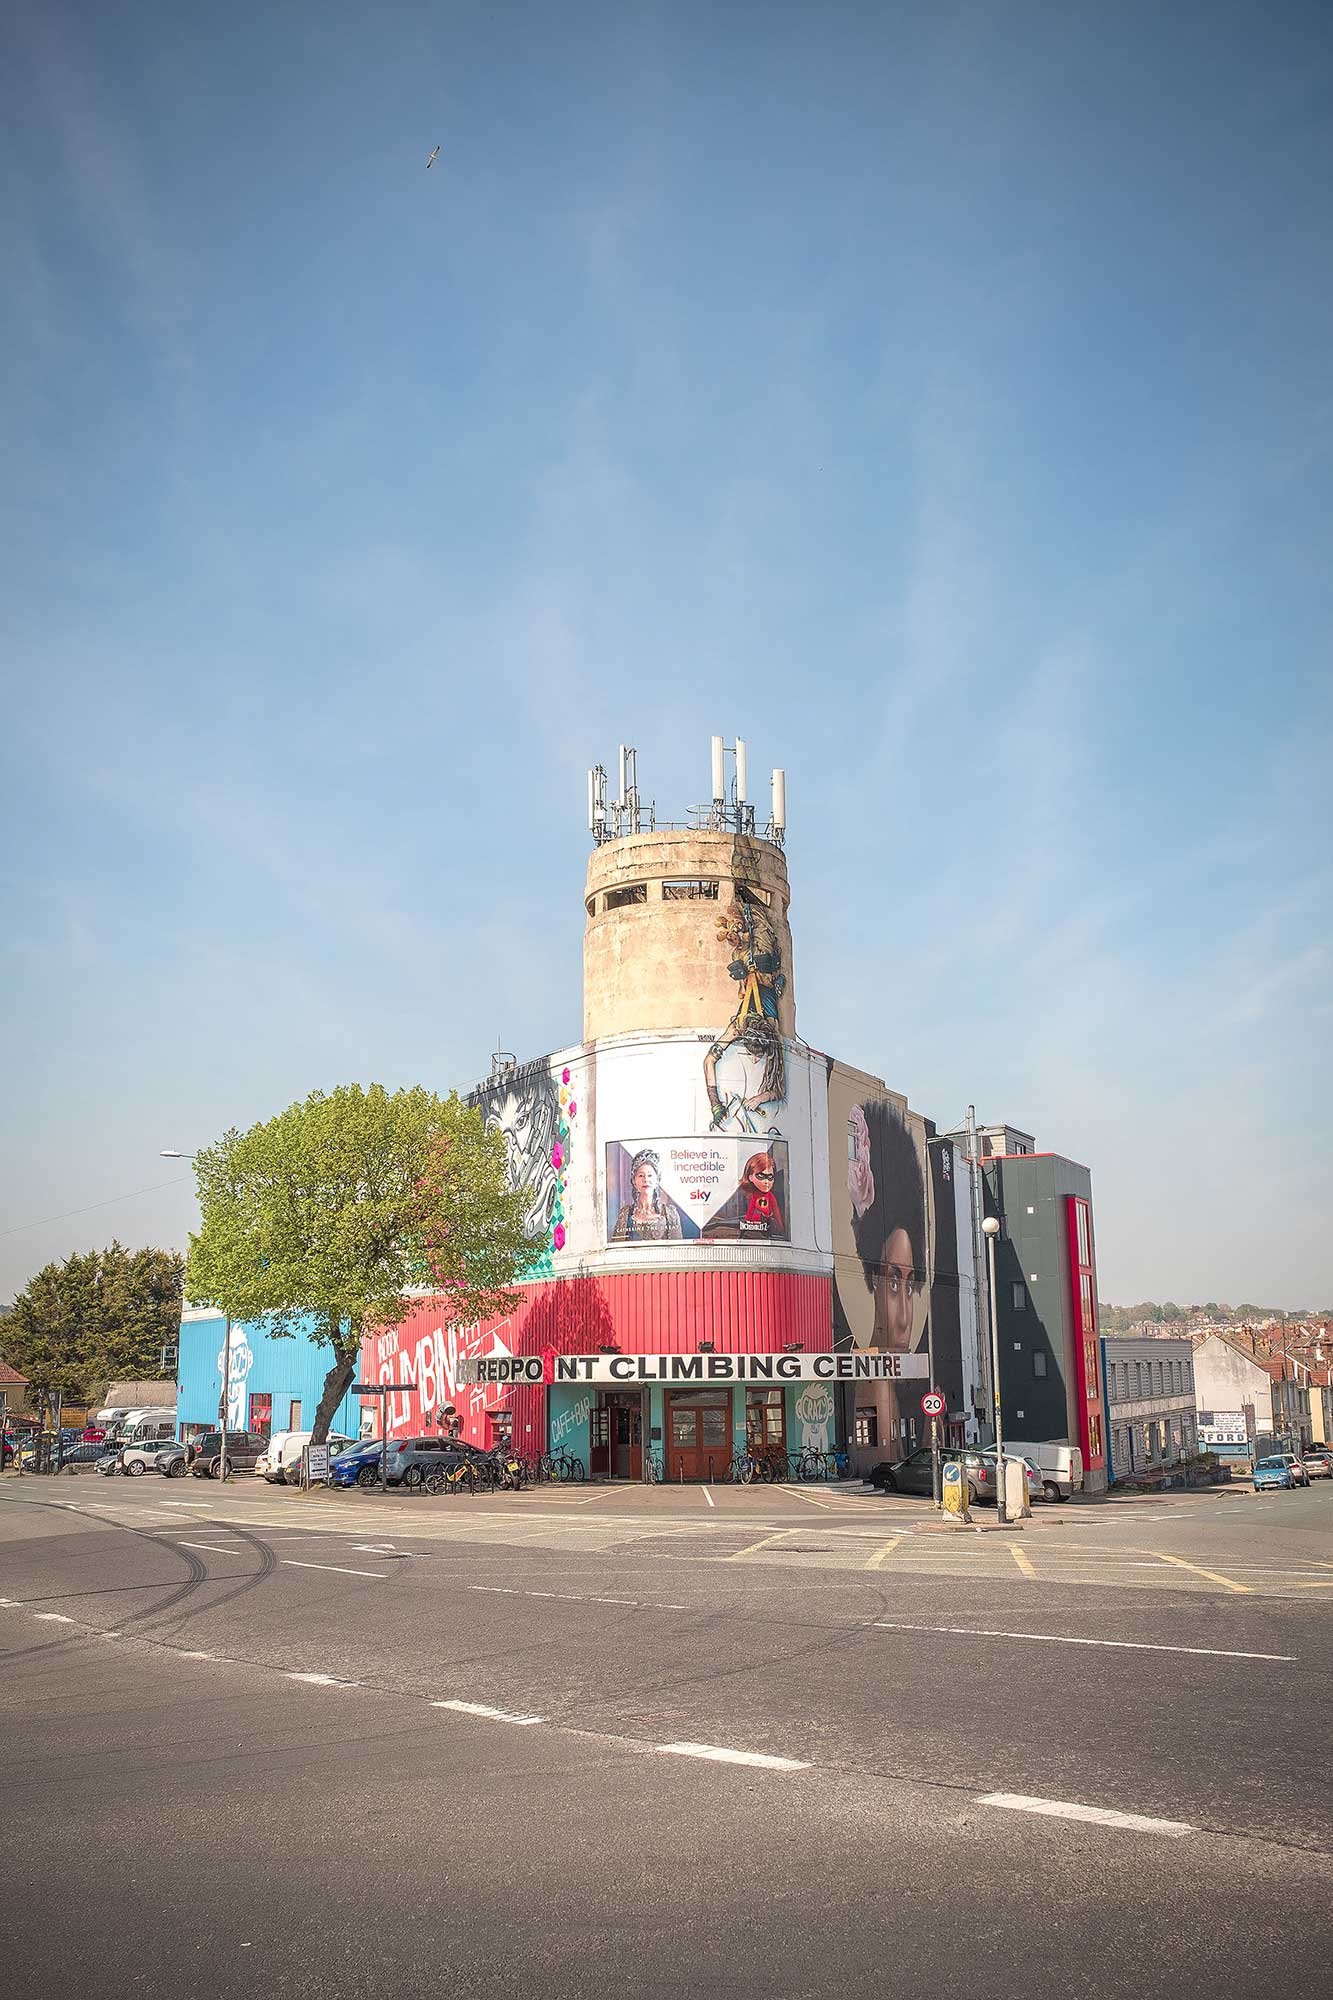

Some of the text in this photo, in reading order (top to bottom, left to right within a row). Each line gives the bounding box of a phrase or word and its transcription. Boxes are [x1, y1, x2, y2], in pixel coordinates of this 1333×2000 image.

[670, 1148, 728, 1160] Believe in...
[673, 1161, 725, 1171] incredible
[679, 1175, 719, 1184] women
[690, 1189, 711, 1202] sky
[609, 1356, 802, 1379] CLIMBING
[812, 1355, 901, 1378] CENTRE
[925, 1399, 941, 1410] 20
[1207, 1433, 1245, 1442] FORD
